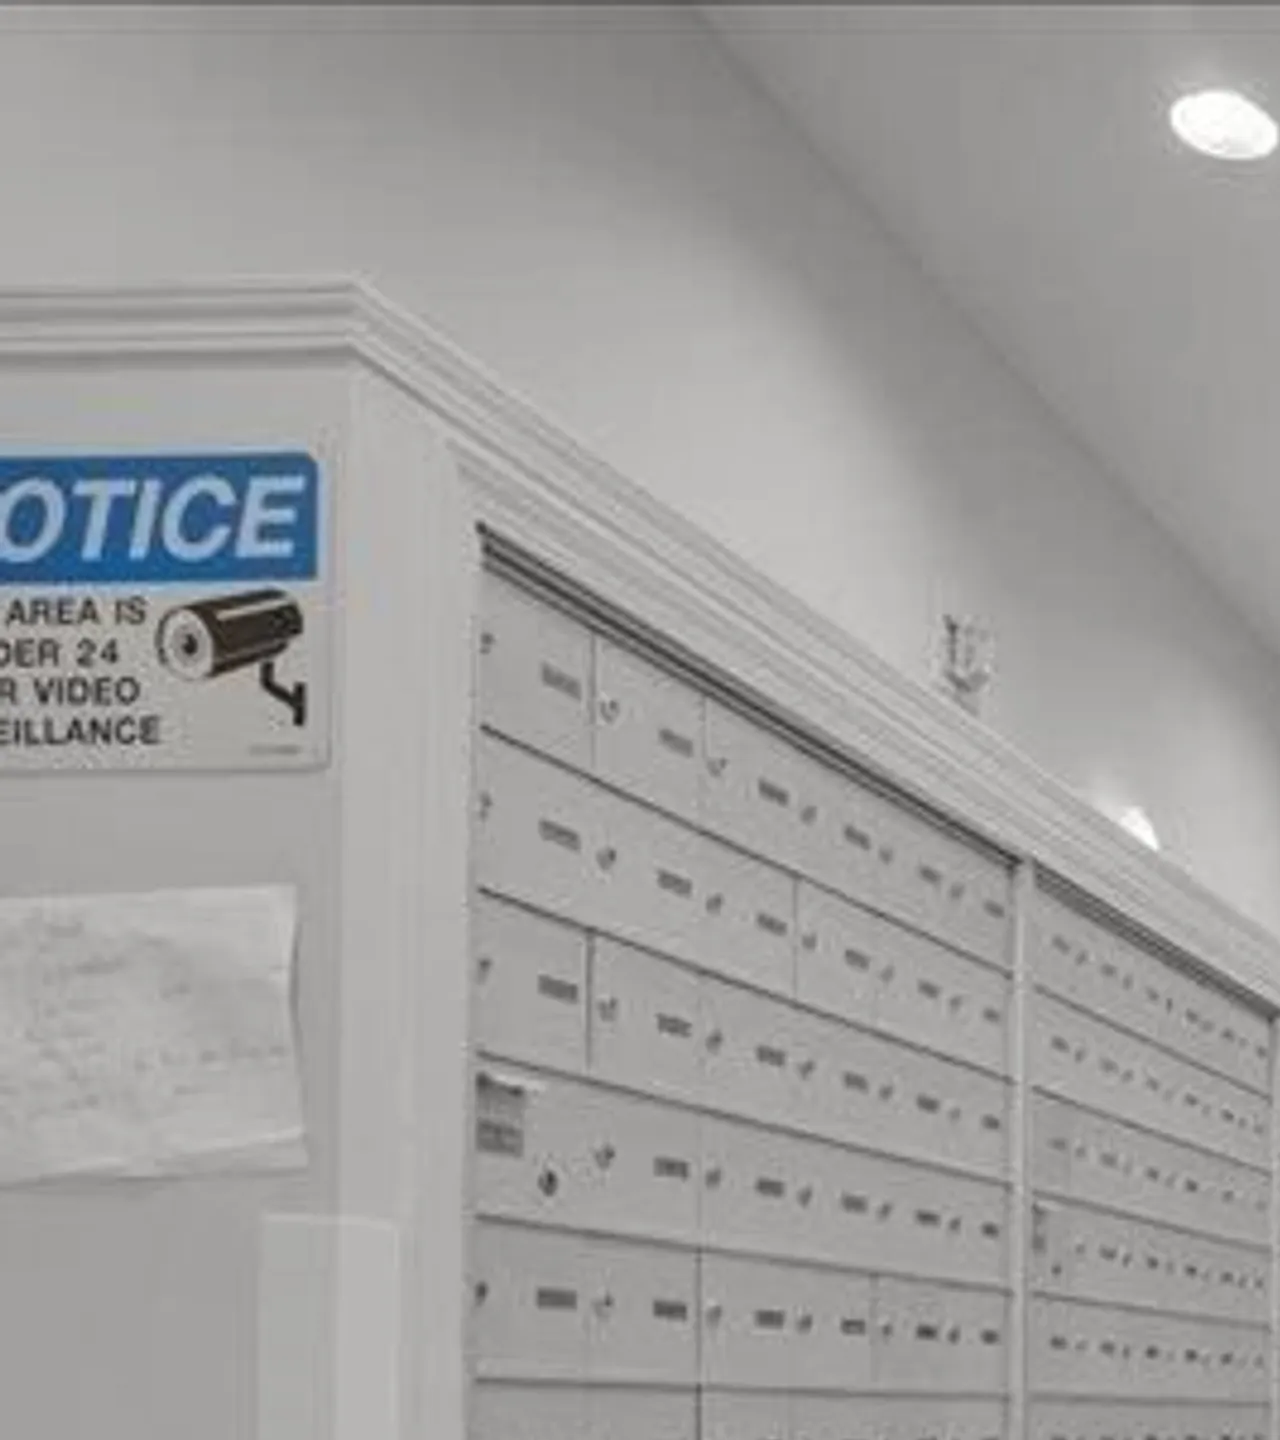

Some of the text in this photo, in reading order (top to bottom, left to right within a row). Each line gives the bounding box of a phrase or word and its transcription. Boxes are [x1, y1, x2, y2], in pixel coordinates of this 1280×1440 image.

[6, 596, 147, 626] AREA IS
[76, 638, 118, 667] 24
[34, 676, 140, 706] VIDEO
